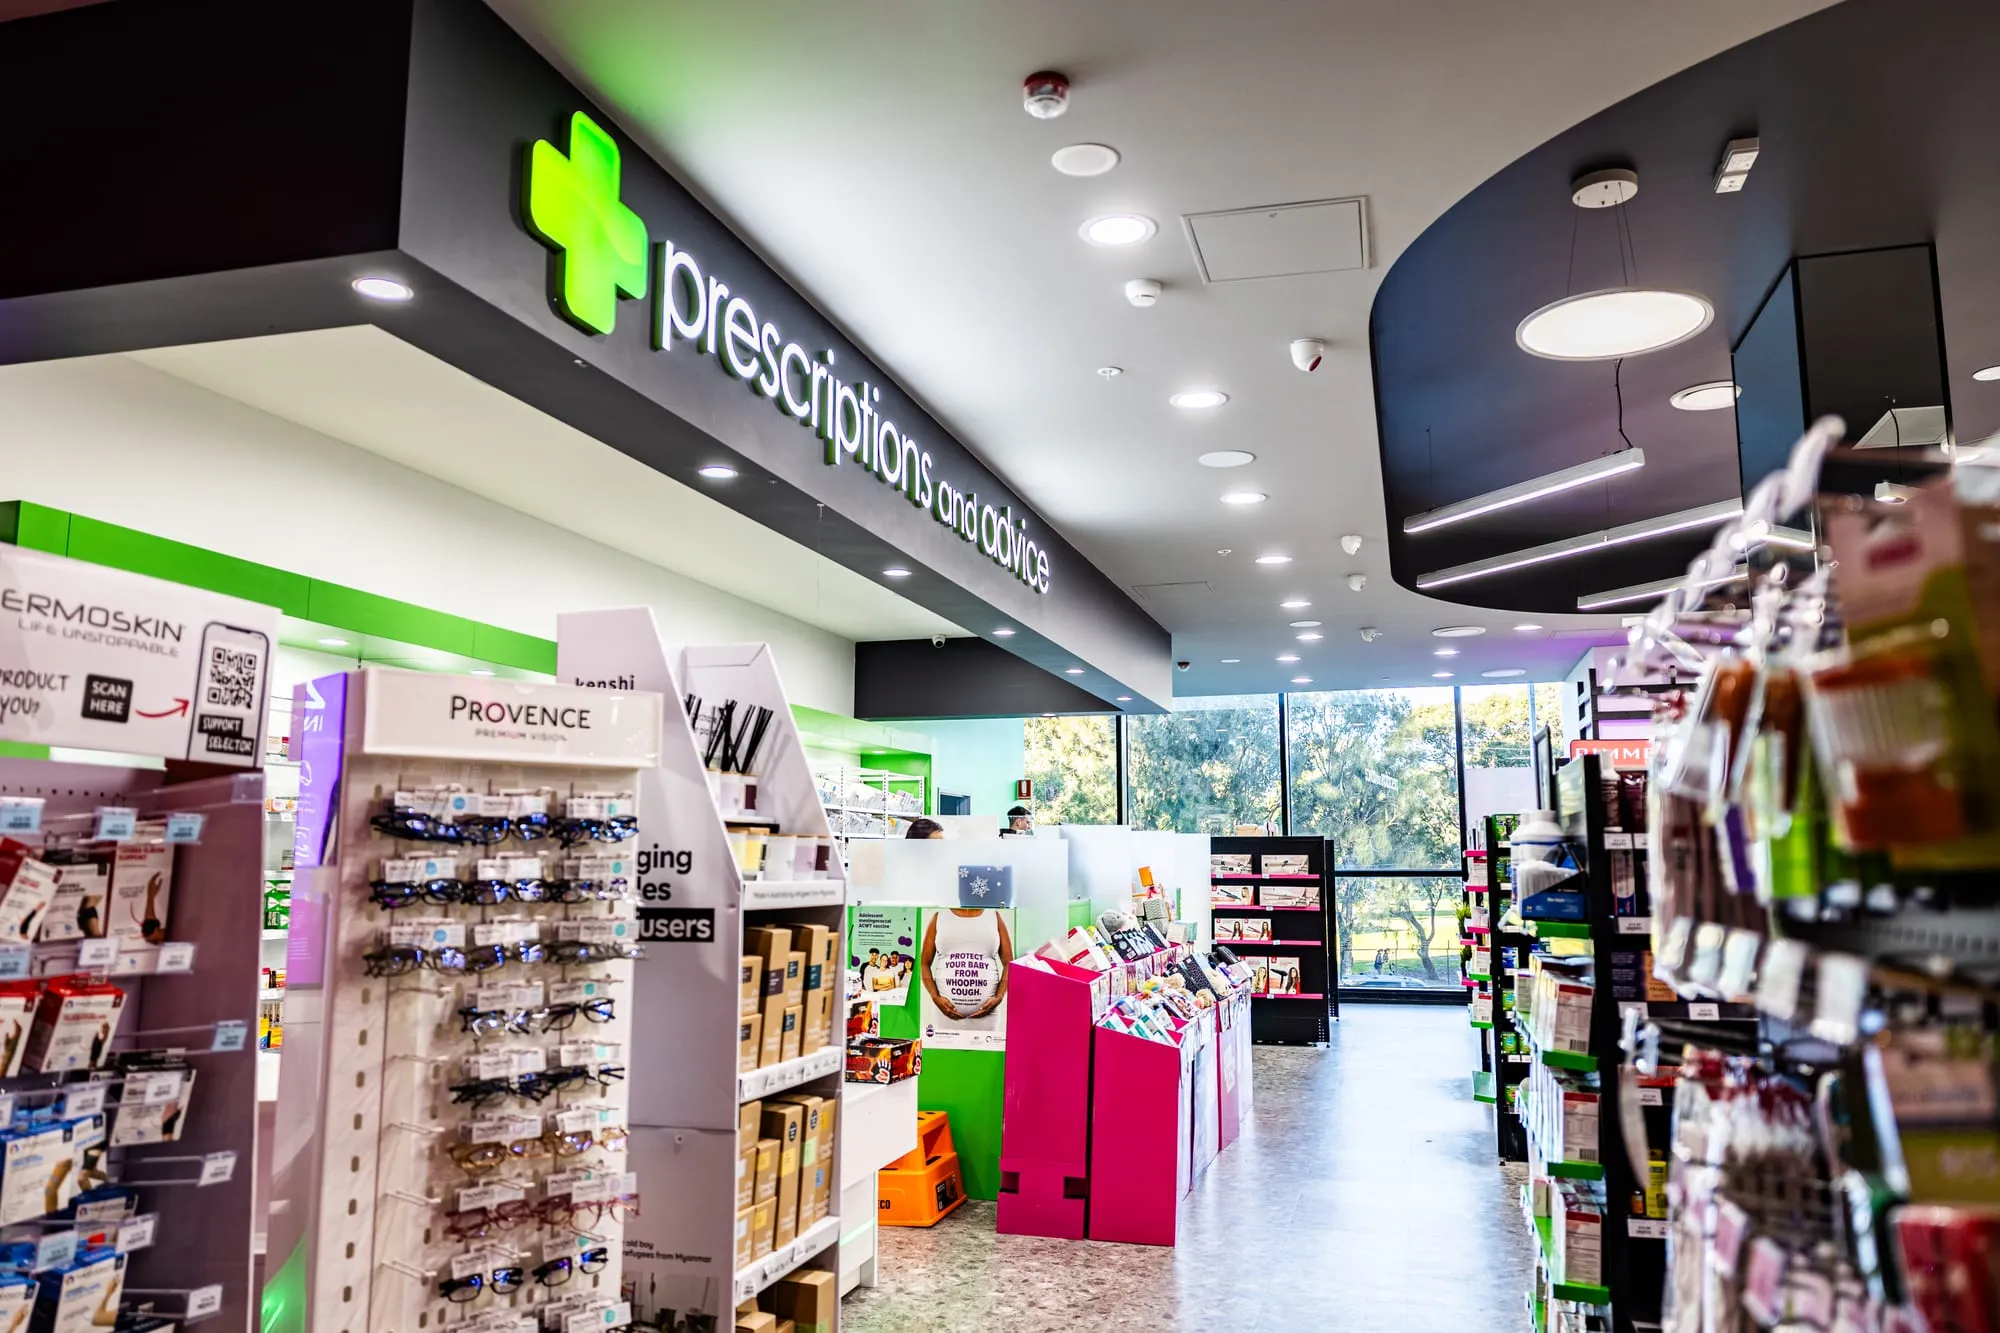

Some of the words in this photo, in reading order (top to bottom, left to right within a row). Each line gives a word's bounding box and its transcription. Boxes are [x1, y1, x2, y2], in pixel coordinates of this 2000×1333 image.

[658, 239, 933, 511] prescriptions
[938, 481, 978, 542] and
[983, 505, 1050, 594] advice
[1, 588, 183, 642] ERMOSKIN
[18, 618, 57, 635] LIFE
[62, 624, 179, 658] UNSTOPPABLE
[91, 682, 127, 698] SCAN
[90, 699, 124, 716] HERE
[450, 695, 591, 730] PROVENCE
[202, 718, 241, 732] SUPPORT
[207, 734, 253, 752] SELECTOR
[474, 728, 527, 741] PREMIUM
[531, 730, 567, 743] VISION
[968, 961, 989, 970] BABY
[955, 969, 979, 978] FROM
[946, 978, 988, 987] WHOOPING
[951, 988, 982, 996] COUGH.
[626, 1239, 638, 1247] old
[639, 1240, 654, 1250] boy
[656, 1251, 674, 1259] from
[675, 1253, 712, 1263] Myanmar
